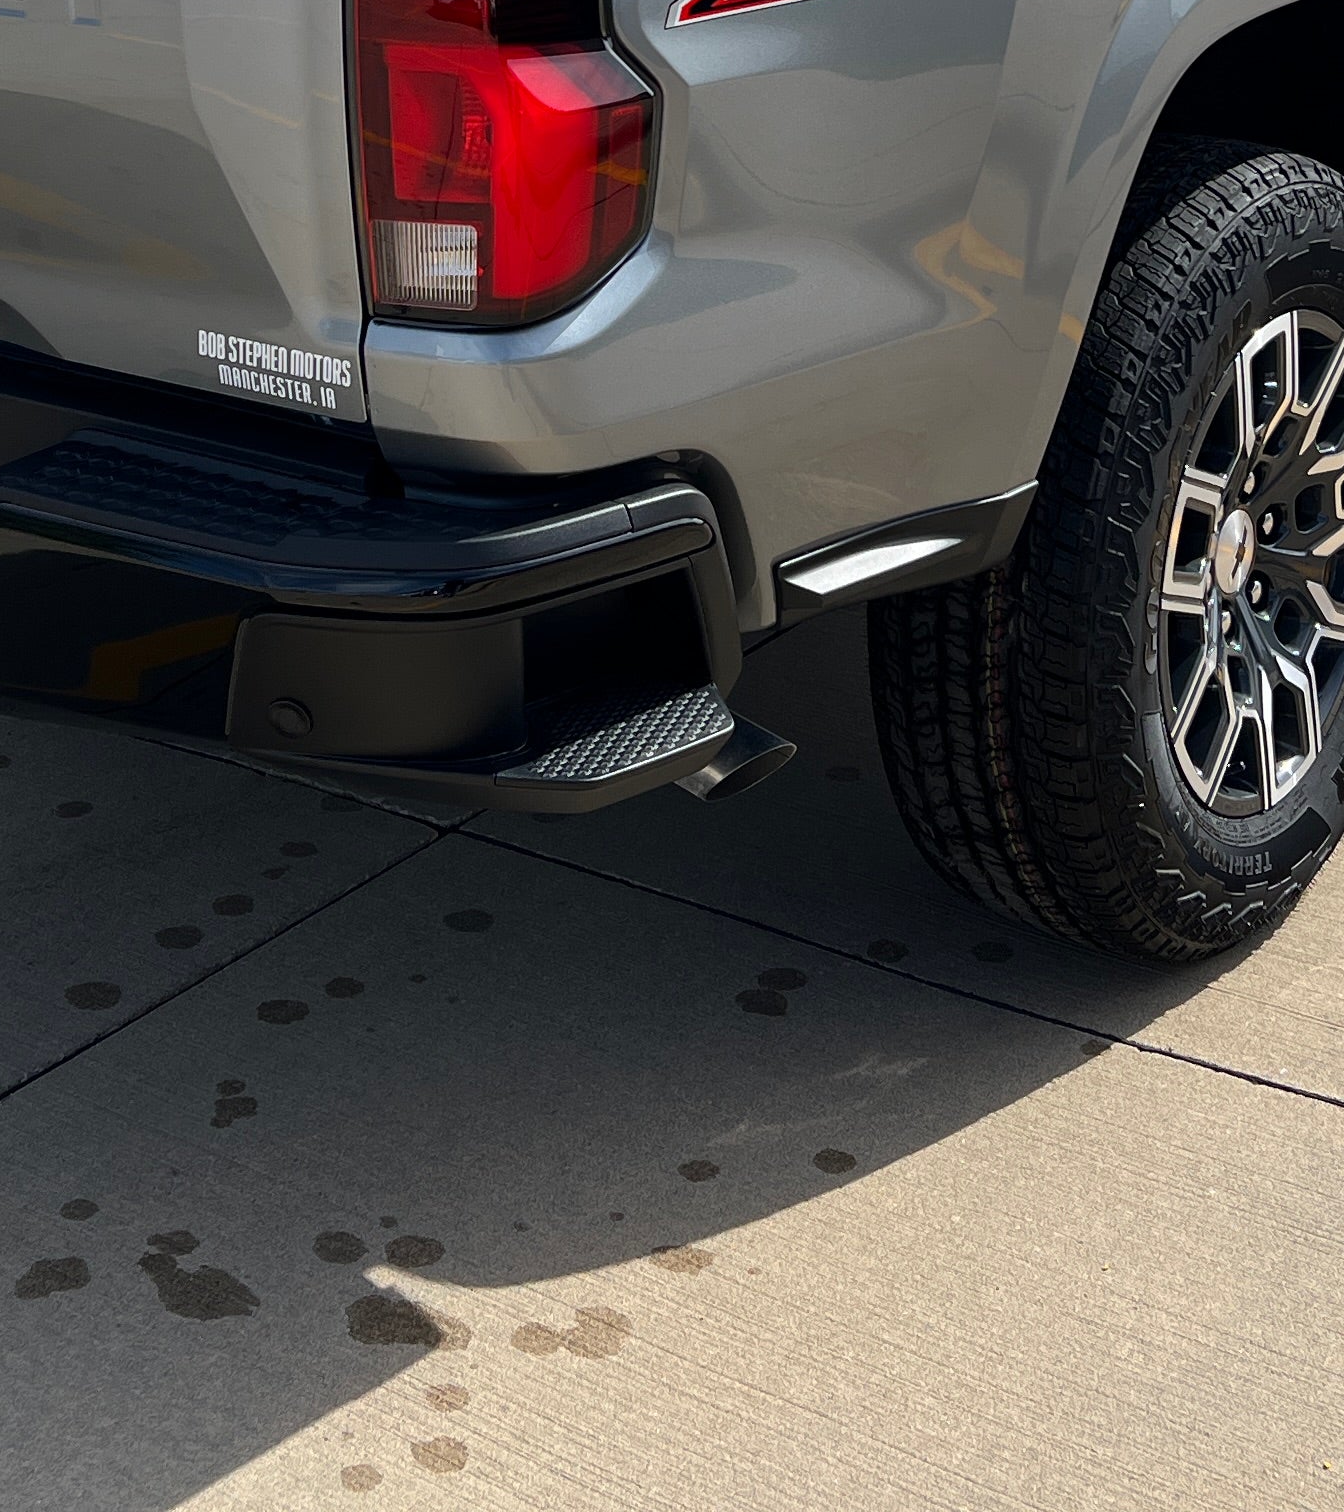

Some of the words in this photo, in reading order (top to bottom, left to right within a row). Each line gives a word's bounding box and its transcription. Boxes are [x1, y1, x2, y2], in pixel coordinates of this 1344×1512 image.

[198, 329, 226, 361] BOB
[228, 335, 288, 375] STEPHEN
[290, 349, 351, 388] MOTORS
[320, 386, 337, 410] IA
